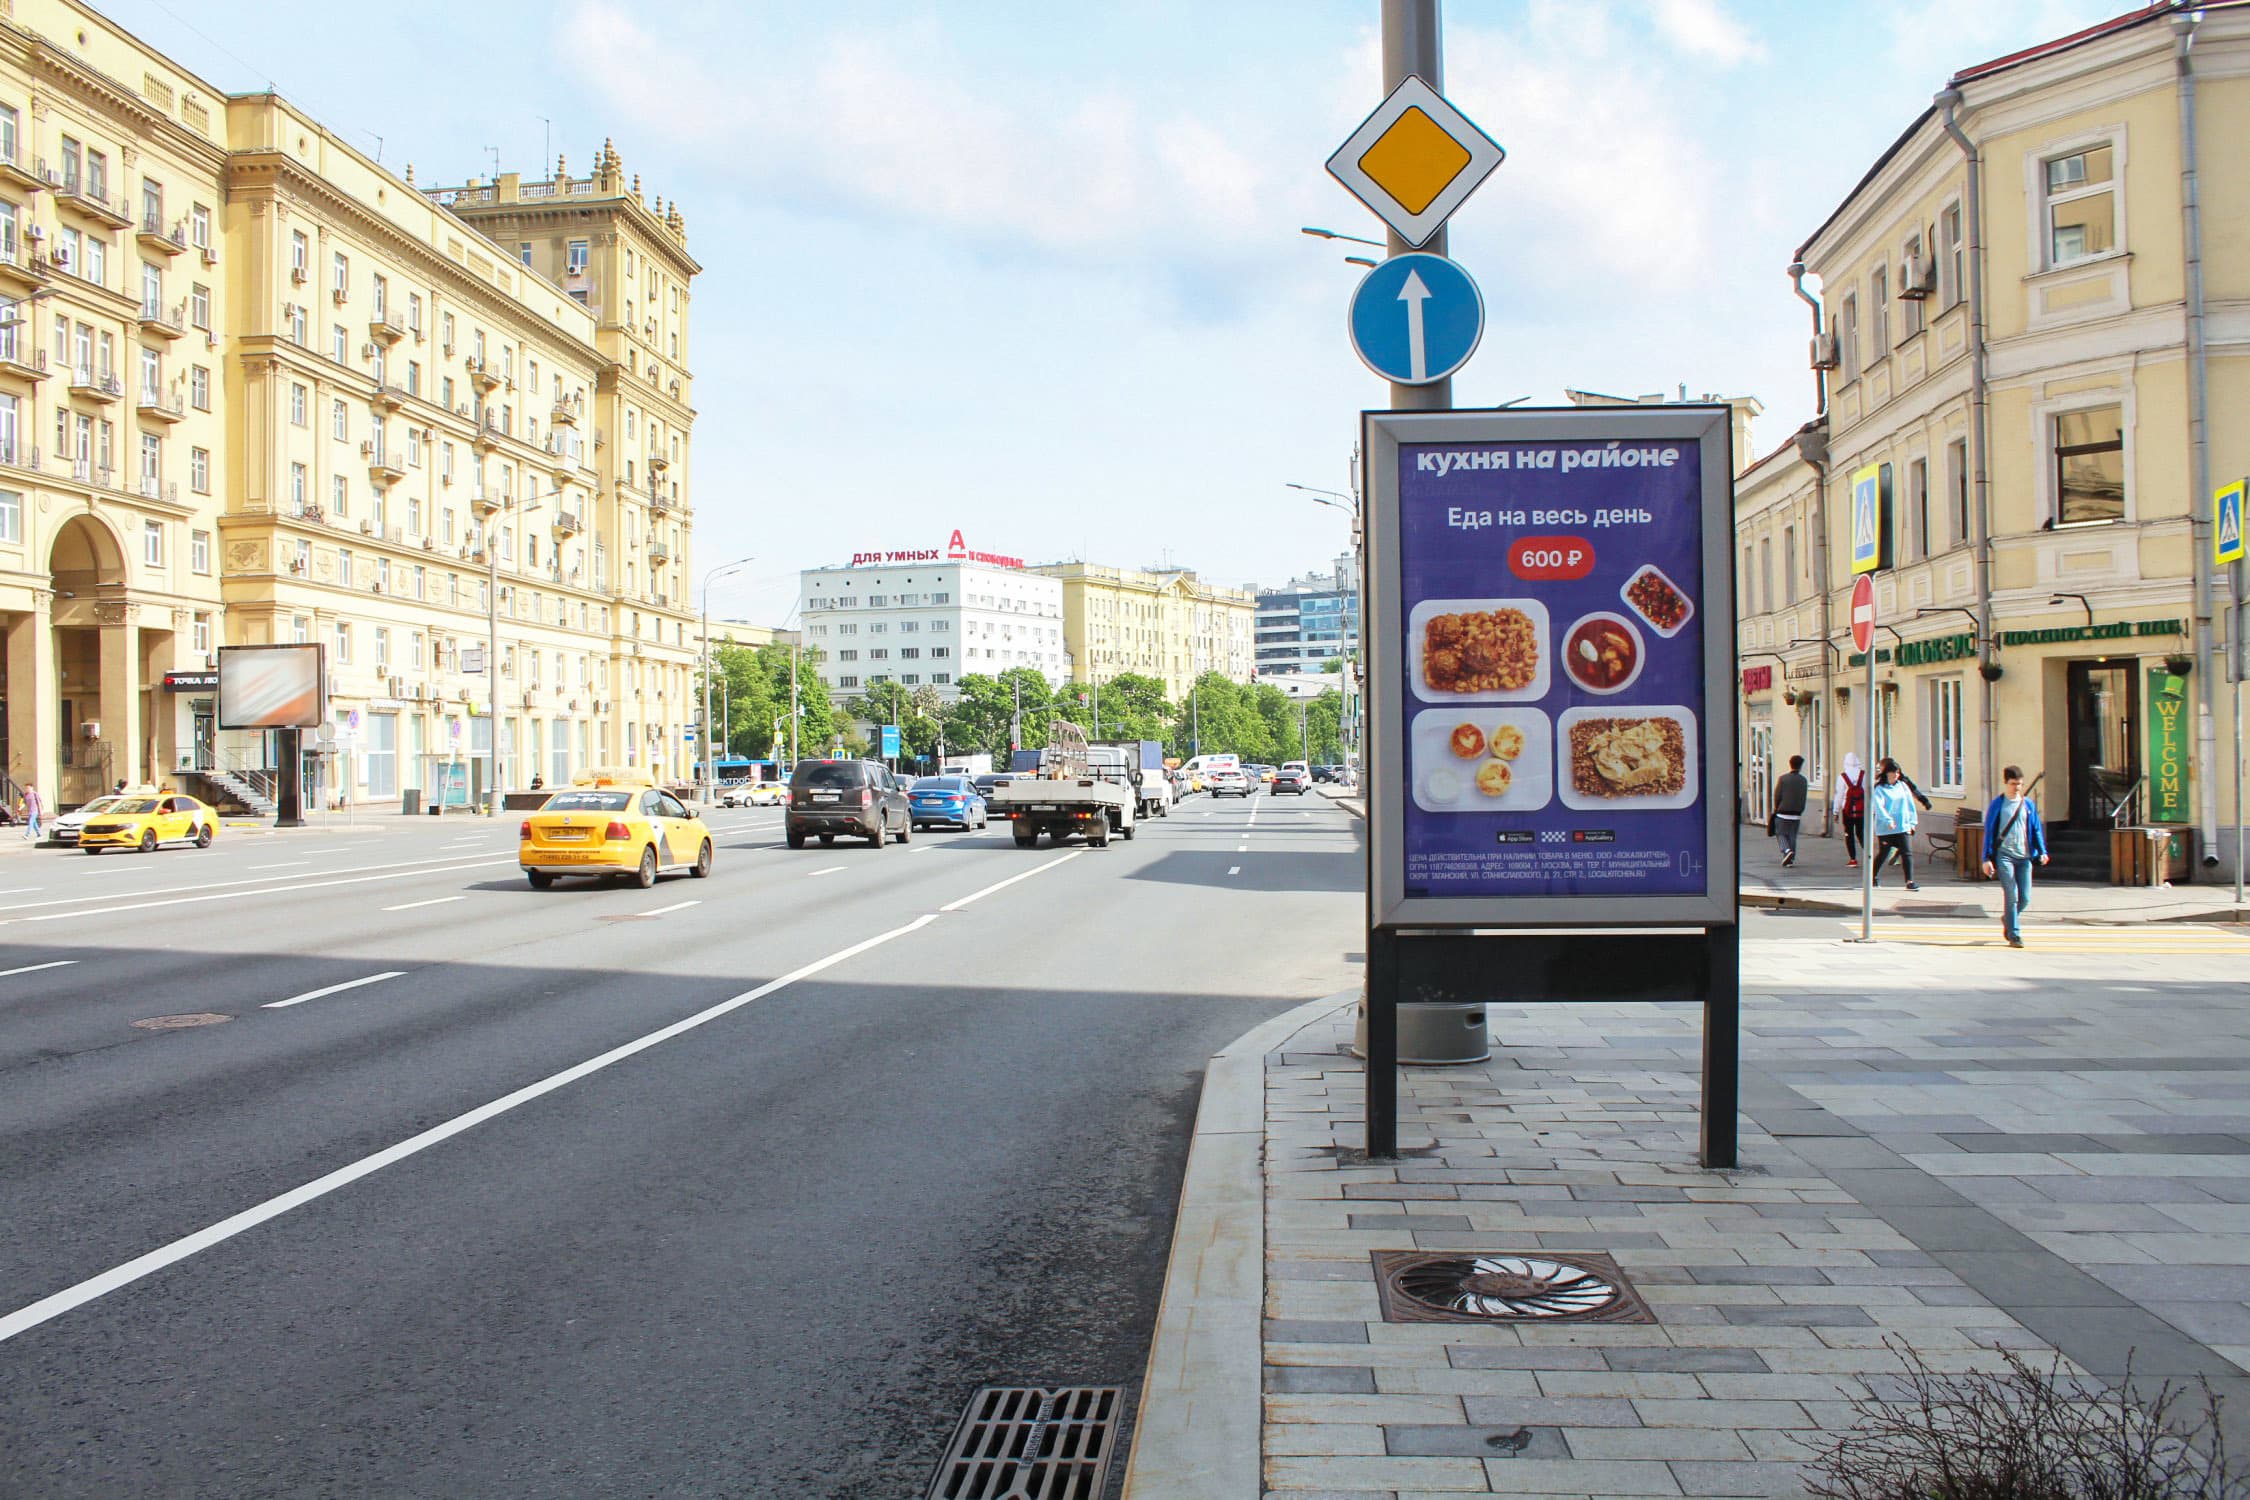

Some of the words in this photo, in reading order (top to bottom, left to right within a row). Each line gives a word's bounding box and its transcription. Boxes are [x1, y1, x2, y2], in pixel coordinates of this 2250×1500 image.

[1417, 451, 1510, 477] кухня
[1516, 449, 1556, 469] на
[1561, 441, 1679, 473] районе
[1448, 507, 1492, 530] Еда
[1498, 510, 1526, 525] на
[1532, 508, 1588, 525] весь
[1593, 507, 1652, 528] день
[852, 552, 882, 566] ДЛЯ
[886, 549, 939, 562] УМНЫХ
[1521, 550, 1562, 568] 600
[2155, 700, 2181, 808] WELCOME
